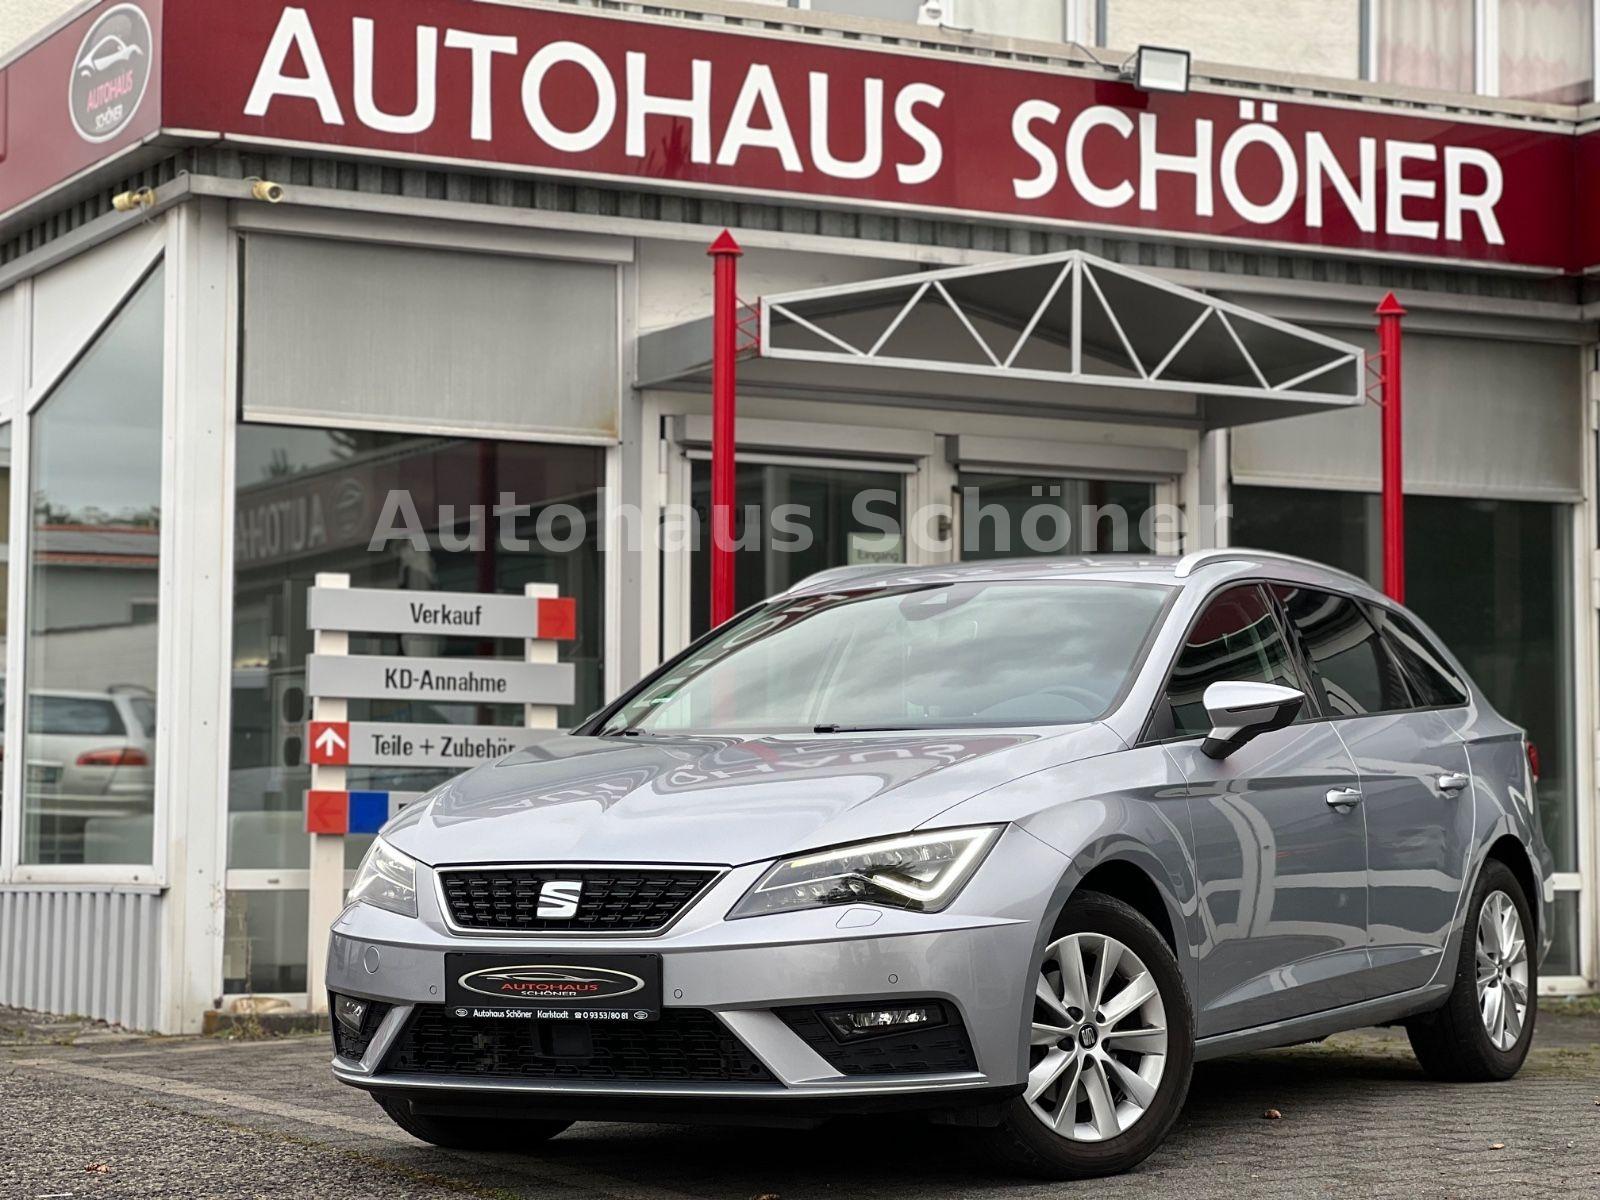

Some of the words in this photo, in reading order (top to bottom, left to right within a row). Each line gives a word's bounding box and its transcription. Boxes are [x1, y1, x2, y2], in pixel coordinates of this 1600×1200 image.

[87, 70, 133, 113] AUTOHAUS
[243, 7, 946, 185] AUTOHAUS
[1011, 99, 1506, 246] SCHÖNER
[410, 602, 482, 626] Verkauf
[384, 667, 507, 693] KD-Annahme
[371, 734, 413, 757] Teile
[419, 739, 434, 755] +
[501, 982, 598, 992] AUTOHAUS
[520, 989, 577, 997] SCHÖNER
[473, 1008, 505, 1018] Autohaus
[506, 1009, 532, 1019] Schöner
[537, 1010, 569, 1019] Karlstadt
